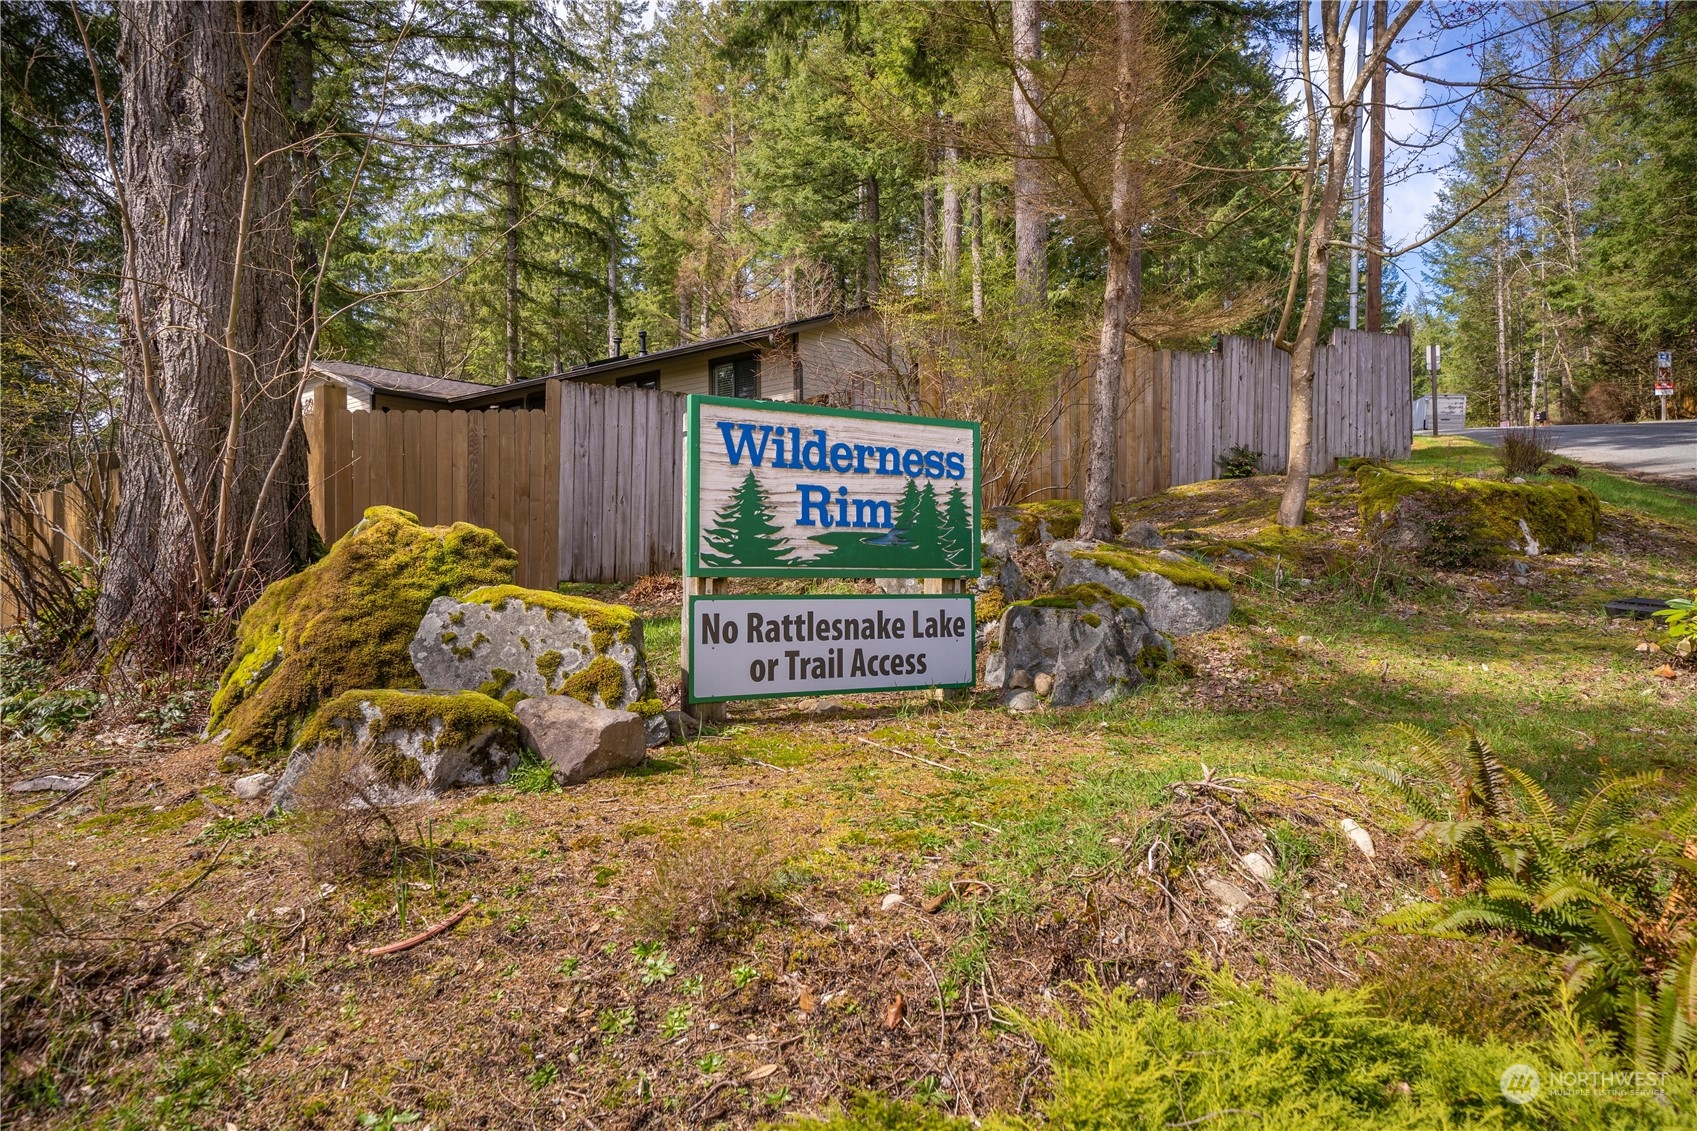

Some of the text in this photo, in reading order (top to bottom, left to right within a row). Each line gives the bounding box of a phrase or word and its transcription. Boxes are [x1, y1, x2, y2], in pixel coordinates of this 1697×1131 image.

[717, 421, 965, 480] Wilderness
[796, 484, 894, 529] Rim
[701, 609, 966, 645] No Rattlesnake Lake
[750, 648, 927, 683] or Trail Access
